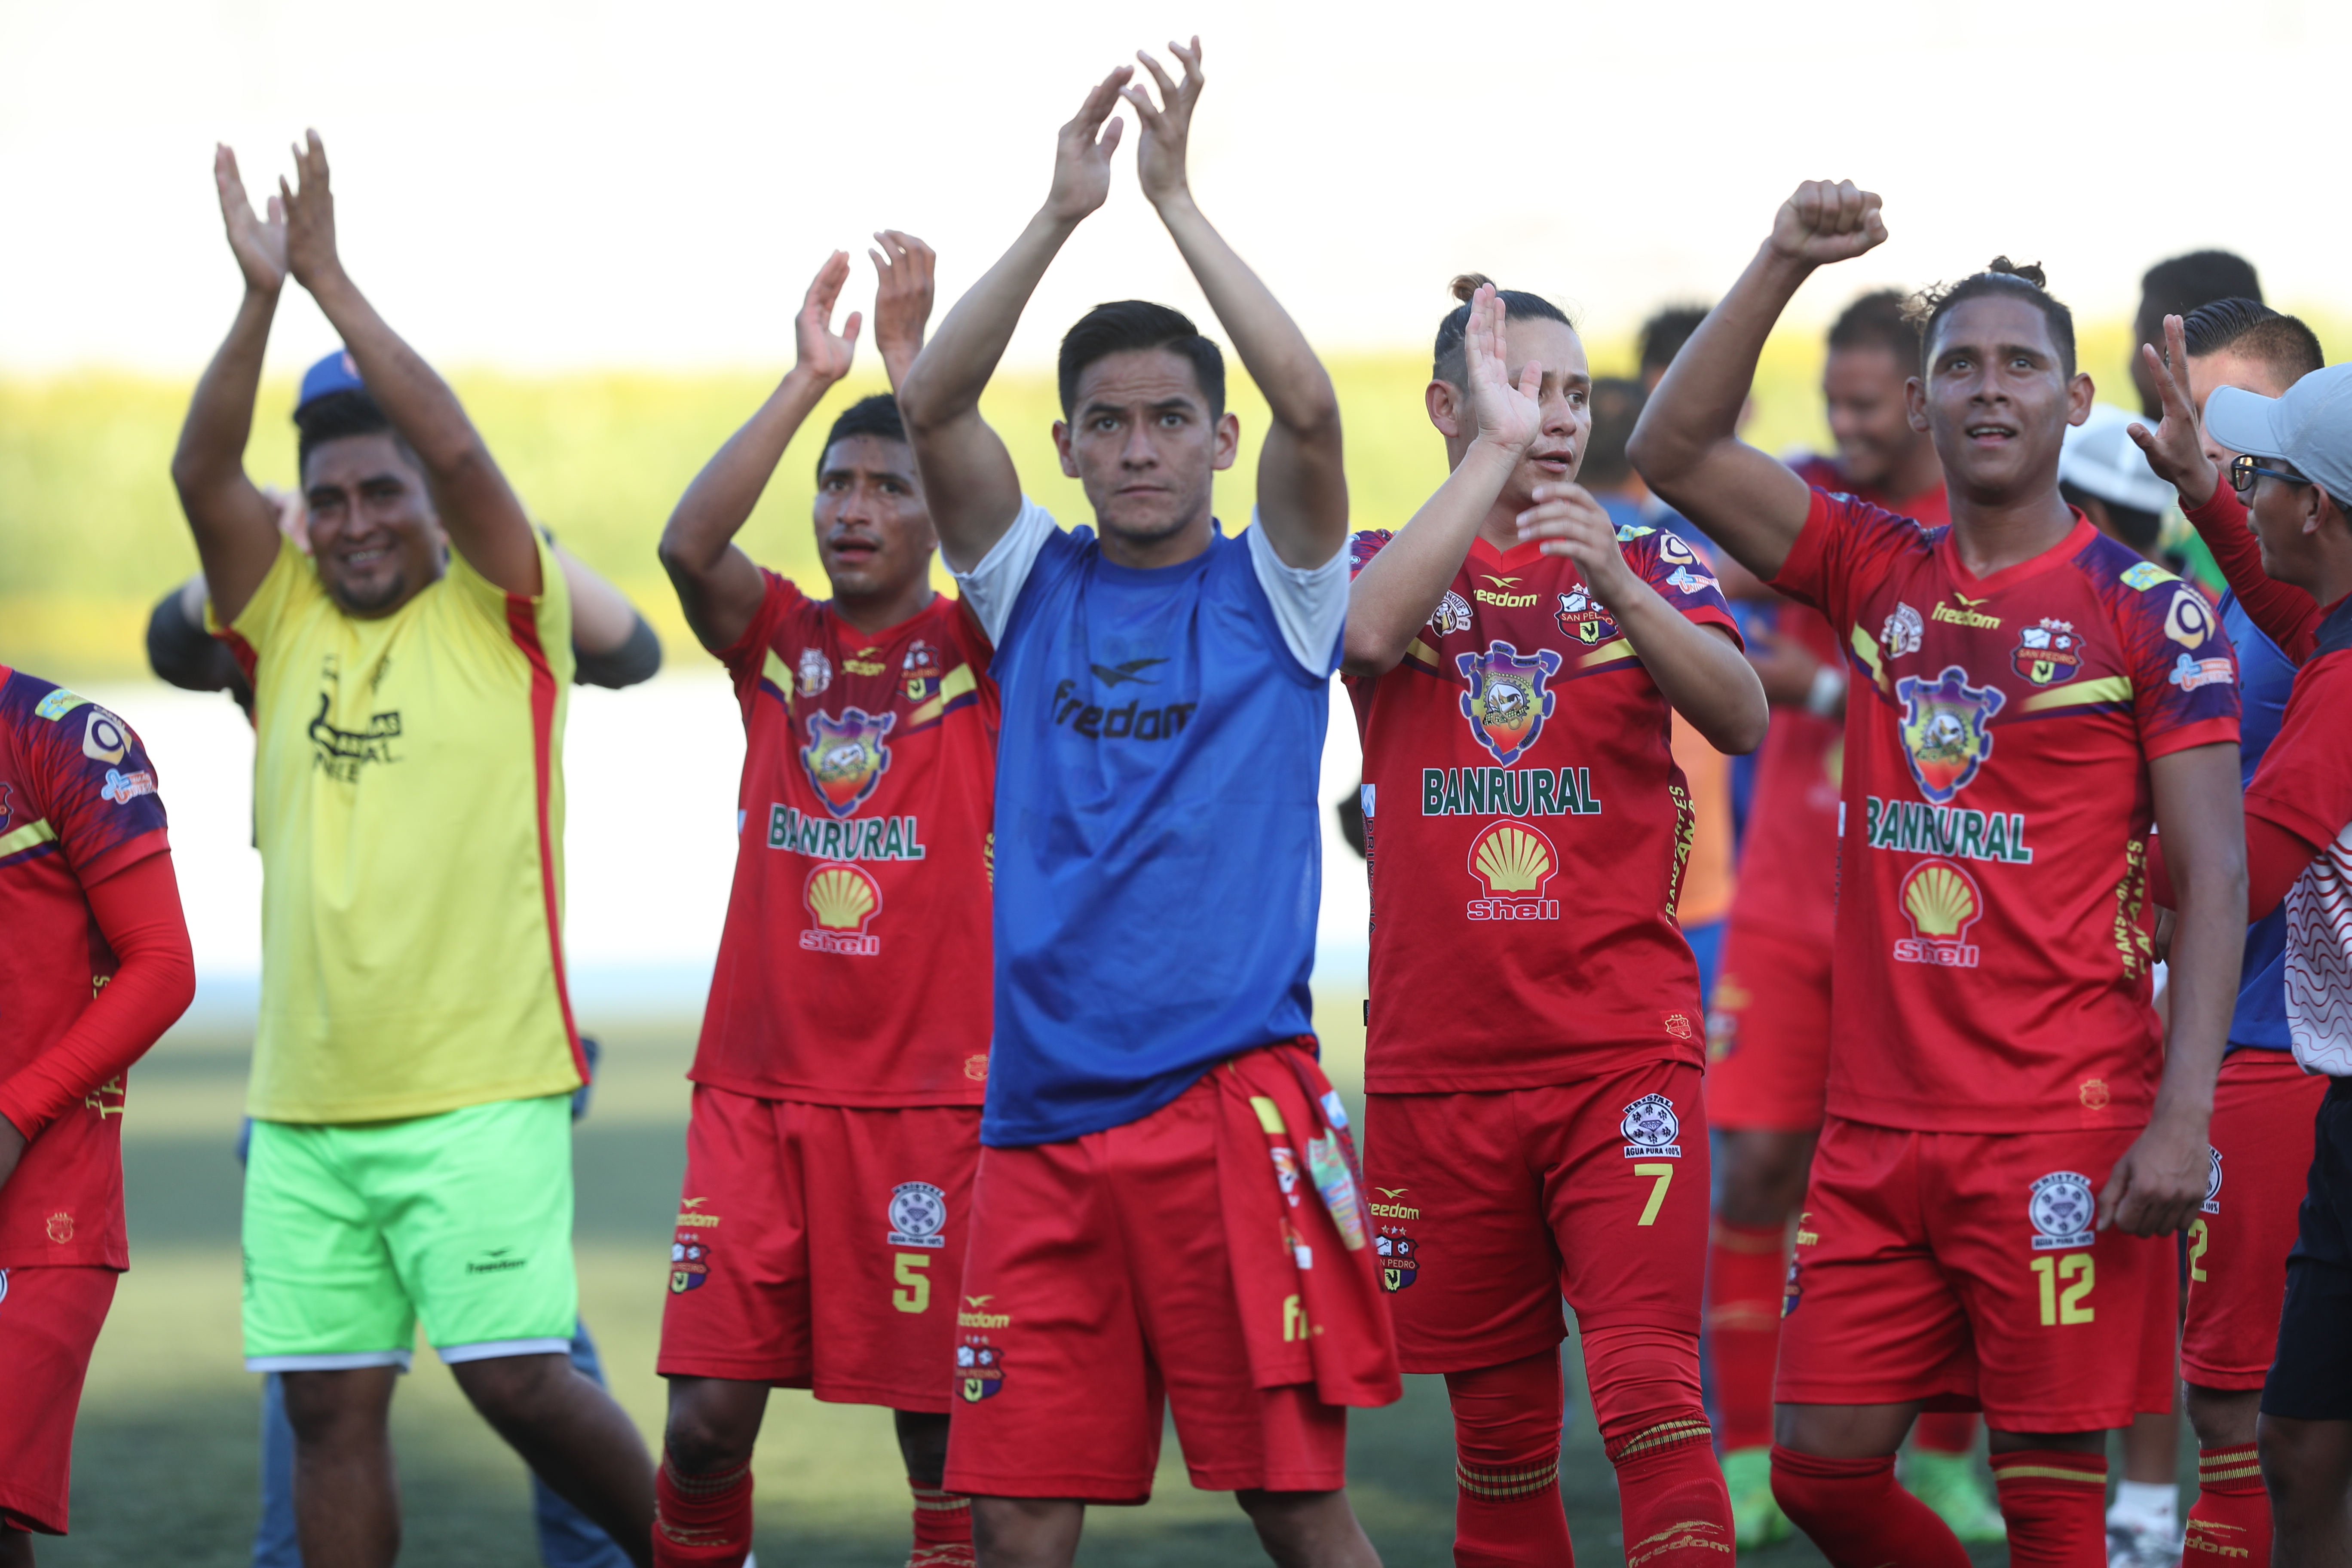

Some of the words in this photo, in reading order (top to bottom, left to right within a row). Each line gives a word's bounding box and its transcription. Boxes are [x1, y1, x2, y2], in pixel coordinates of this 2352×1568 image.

[1473, 589, 1537, 608] eedom
[1562, 612, 1580, 622] SAN
[1931, 601, 2001, 629] freedom
[2018, 648, 2038, 659] SAN
[2039, 650, 2077, 665] PEDRO
[1422, 767, 1602, 818] BANRURAL
[767, 802, 925, 861] BANRURAL
[1867, 795, 2033, 865] BANRURAL
[1467, 900, 1559, 920] Shell
[799, 929, 880, 956] Shell
[1893, 938, 1979, 968] Shell
[1624, 1095, 1671, 1114] KRISTAL
[1626, 1147, 1644, 1157] AGUA
[1665, 1147, 1680, 1156] 100%
[1634, 1163, 1673, 1225] 7
[1369, 1202, 1419, 1220] eedom
[2205, 1203, 2218, 1213] 100%
[1387, 1259, 1415, 1269] PEDRO
[892, 1253, 931, 1314] 5
[2030, 1253, 2095, 1326] 12
